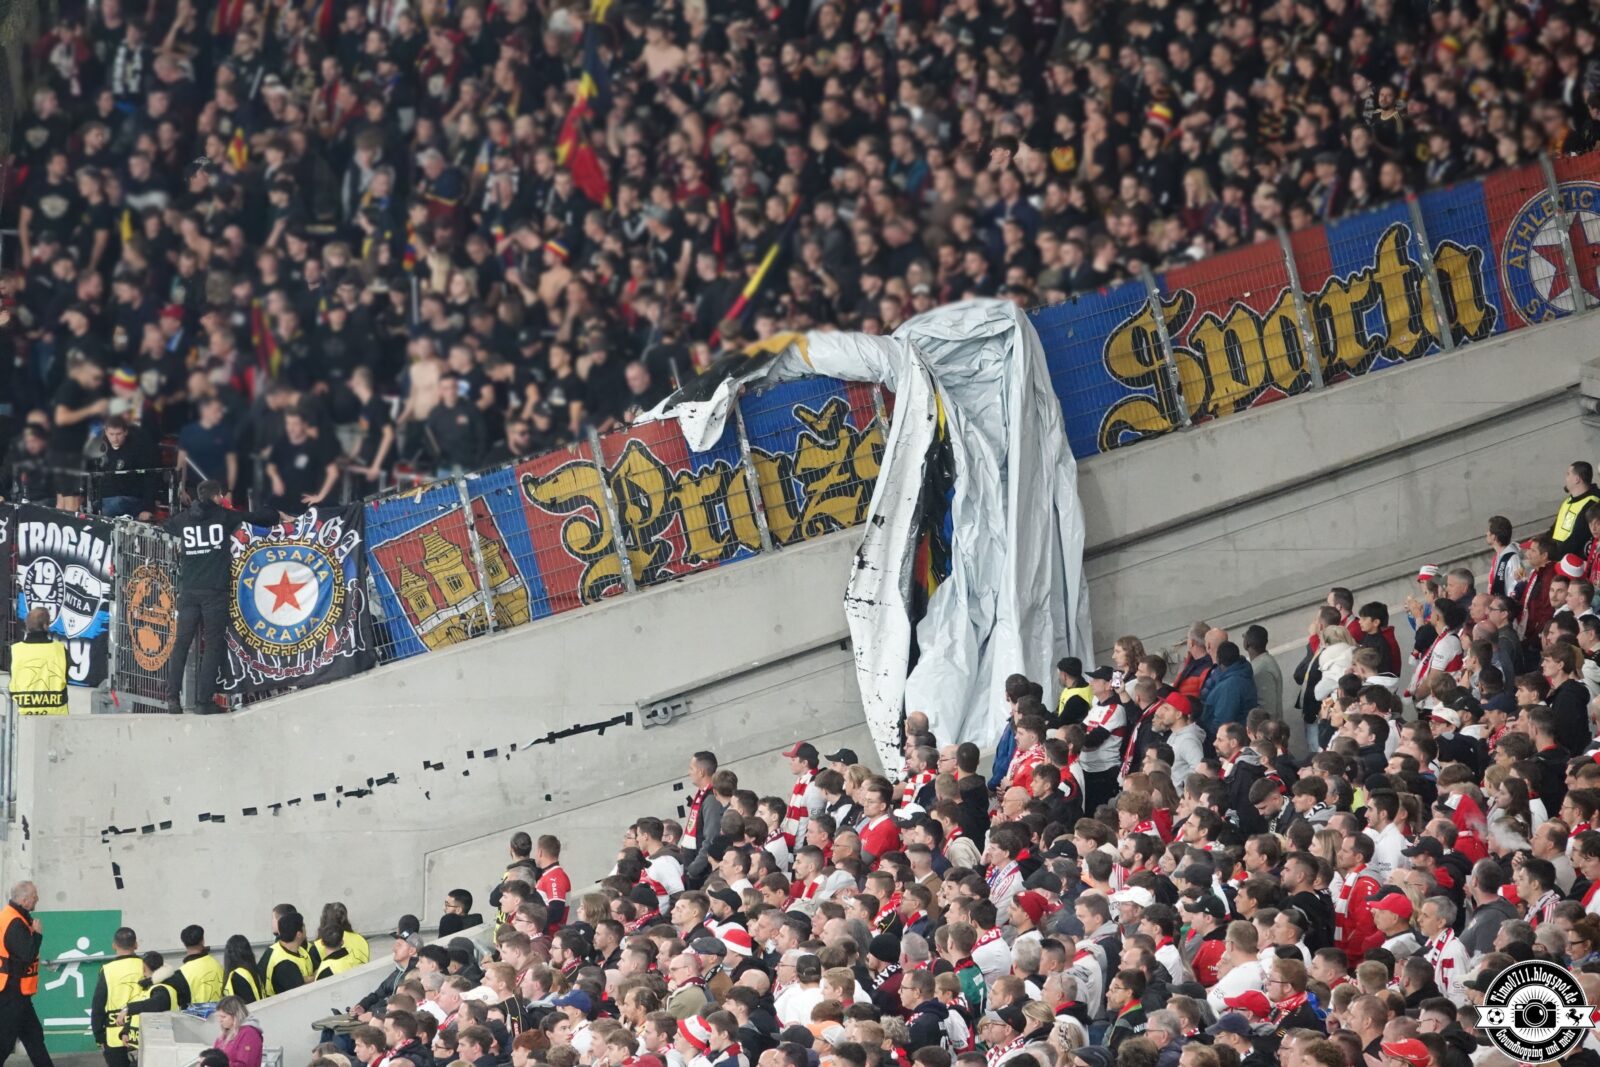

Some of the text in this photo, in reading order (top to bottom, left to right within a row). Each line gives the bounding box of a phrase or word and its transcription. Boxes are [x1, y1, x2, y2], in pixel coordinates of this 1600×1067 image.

[183, 523, 223, 548] SLO
[34, 561, 56, 584] 19
[243, 549, 329, 590] AC SPARTA
[66, 591, 92, 613] NITRA
[254, 617, 320, 641] PRAHA
